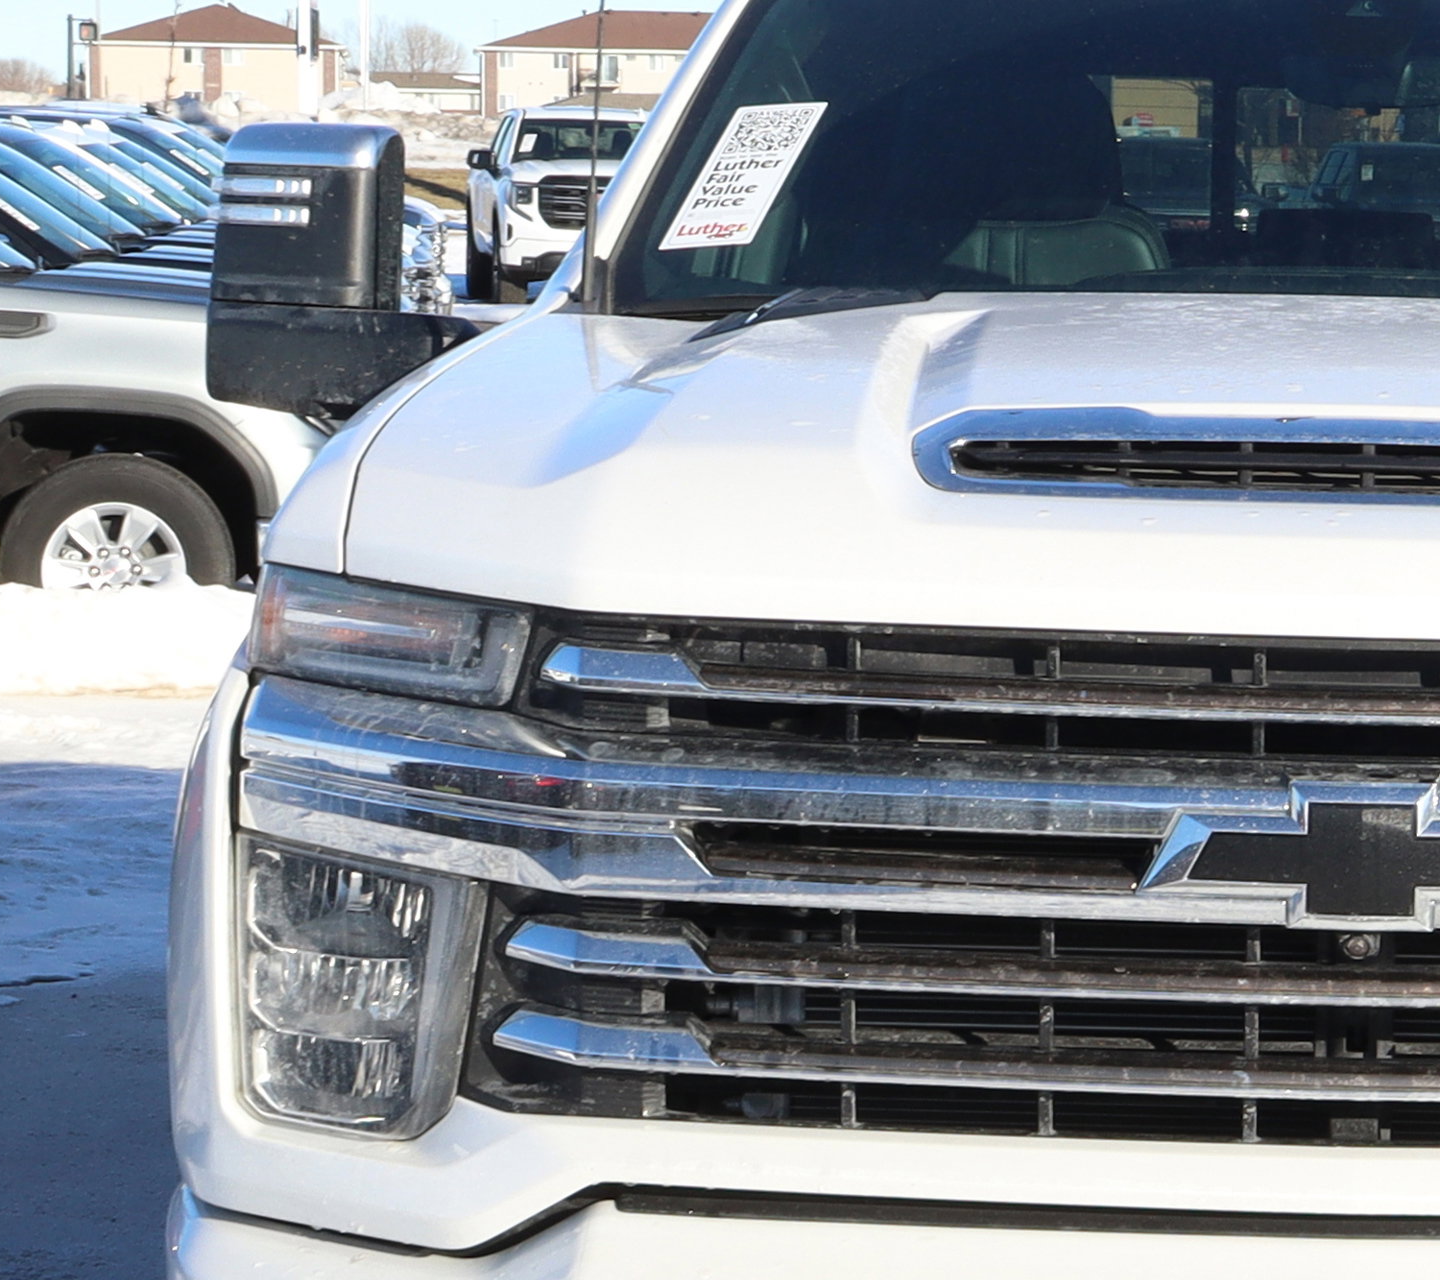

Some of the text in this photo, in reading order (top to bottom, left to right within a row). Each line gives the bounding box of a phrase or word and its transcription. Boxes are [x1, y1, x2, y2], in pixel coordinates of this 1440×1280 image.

[712, 158, 784, 172] Luther
[705, 172, 745, 184] Fair
[701, 183, 759, 197] Value
[691, 196, 745, 210] Price
[676, 222, 748, 238] Luther
